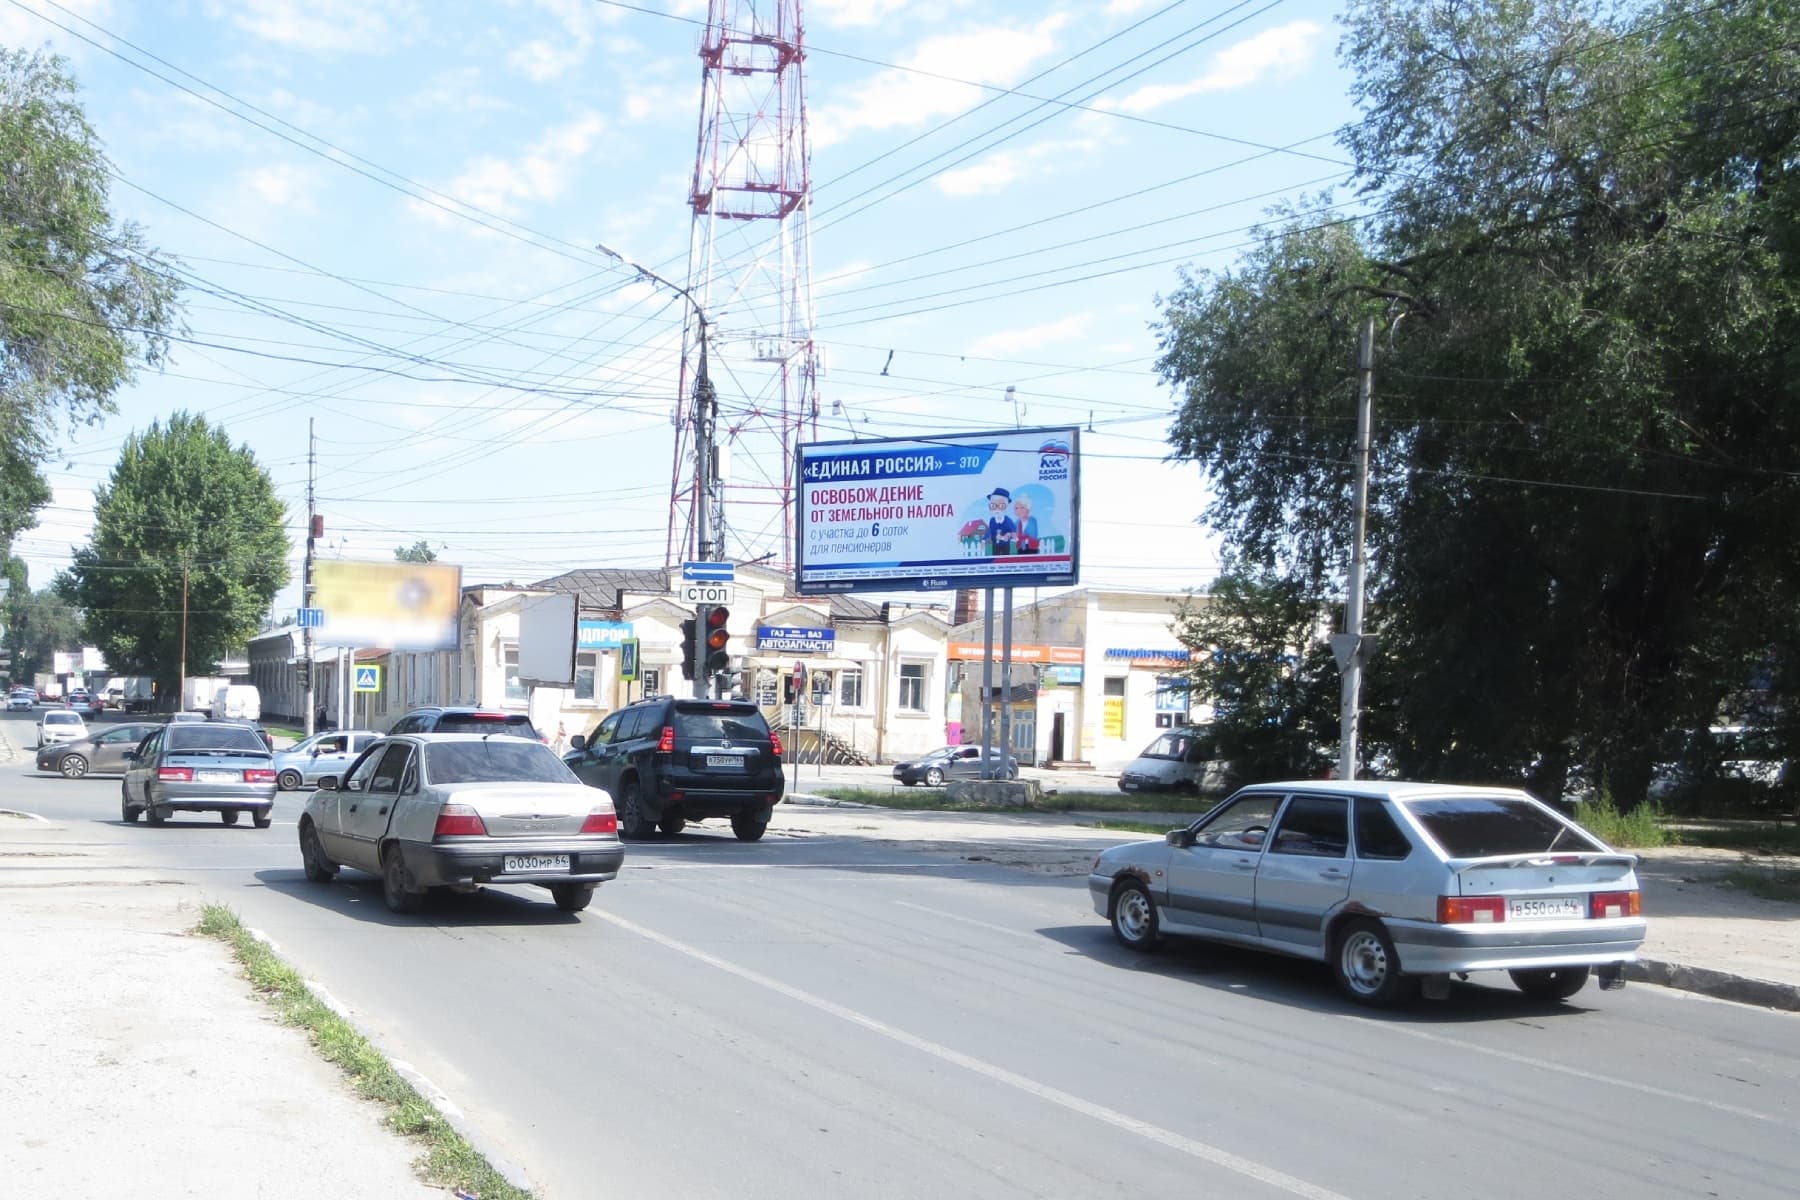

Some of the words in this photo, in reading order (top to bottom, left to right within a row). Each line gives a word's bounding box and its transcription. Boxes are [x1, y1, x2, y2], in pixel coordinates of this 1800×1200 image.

[803, 459, 871, 480] «ЕДИНАЯ
[875, 455, 943, 474] РОССИЯ»
[959, 455, 980, 469] ЭТО
[811, 484, 924, 505] ОСВОБОЖДЕНИЕ
[811, 509, 825, 523] ОТ
[828, 505, 904, 522] ЗЕМЕЛЬНОГО
[907, 503, 954, 519] НАЛОГА
[810, 530, 817, 540] с
[818, 527, 855, 542] участка
[856, 527, 869, 539] до
[871, 522, 880, 537] 6
[882, 525, 909, 537] соток
[809, 543, 830, 556] для
[831, 541, 892, 555] пенсионеров
[687, 588, 728, 601] СТОП
[770, 629, 785, 638] ГАЗ
[807, 630, 823, 639] ВАЗ
[759, 638, 833, 652] АВТОЗАПЧАСТИ
